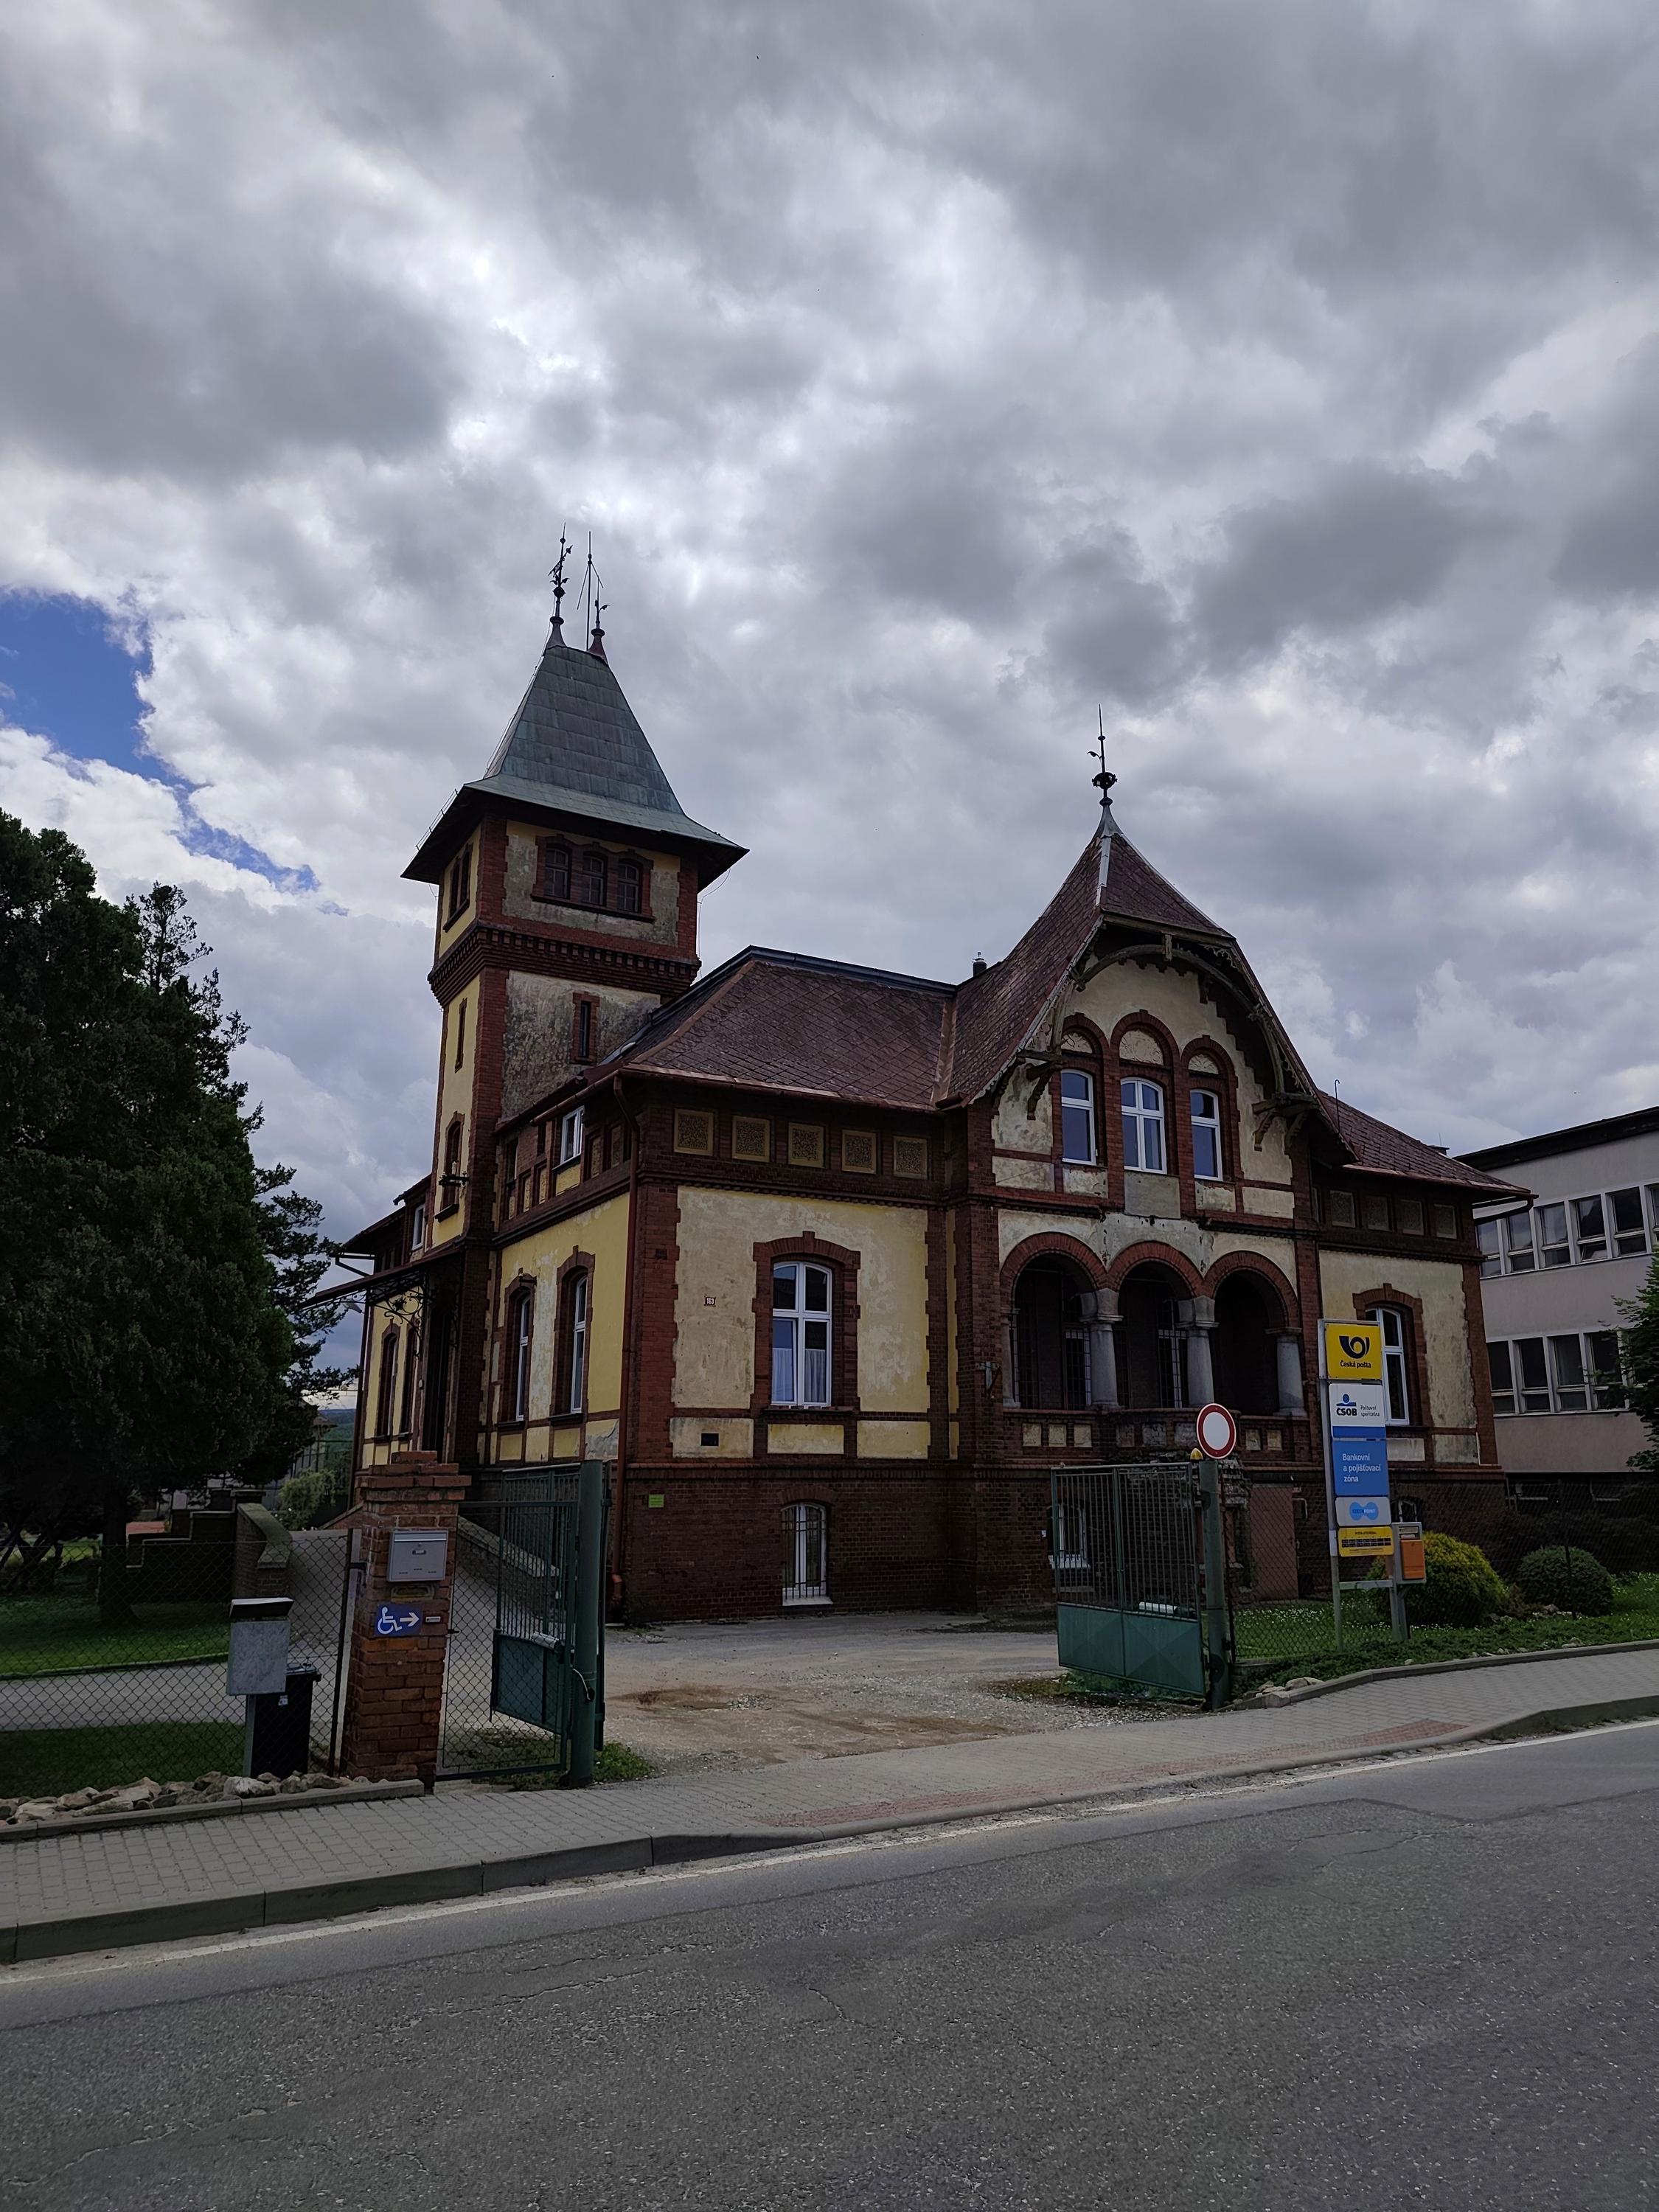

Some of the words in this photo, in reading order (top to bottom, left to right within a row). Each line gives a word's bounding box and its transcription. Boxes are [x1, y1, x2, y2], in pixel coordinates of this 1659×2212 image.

[1340, 1360, 1356, 1368] Česká
[1336, 1407, 1357, 1416] ČSOB
[1342, 1453, 1370, 1461] Bankovní
[1348, 1464, 1381, 1473] pojišťovací
[1343, 1474, 1359, 1482] zóna
